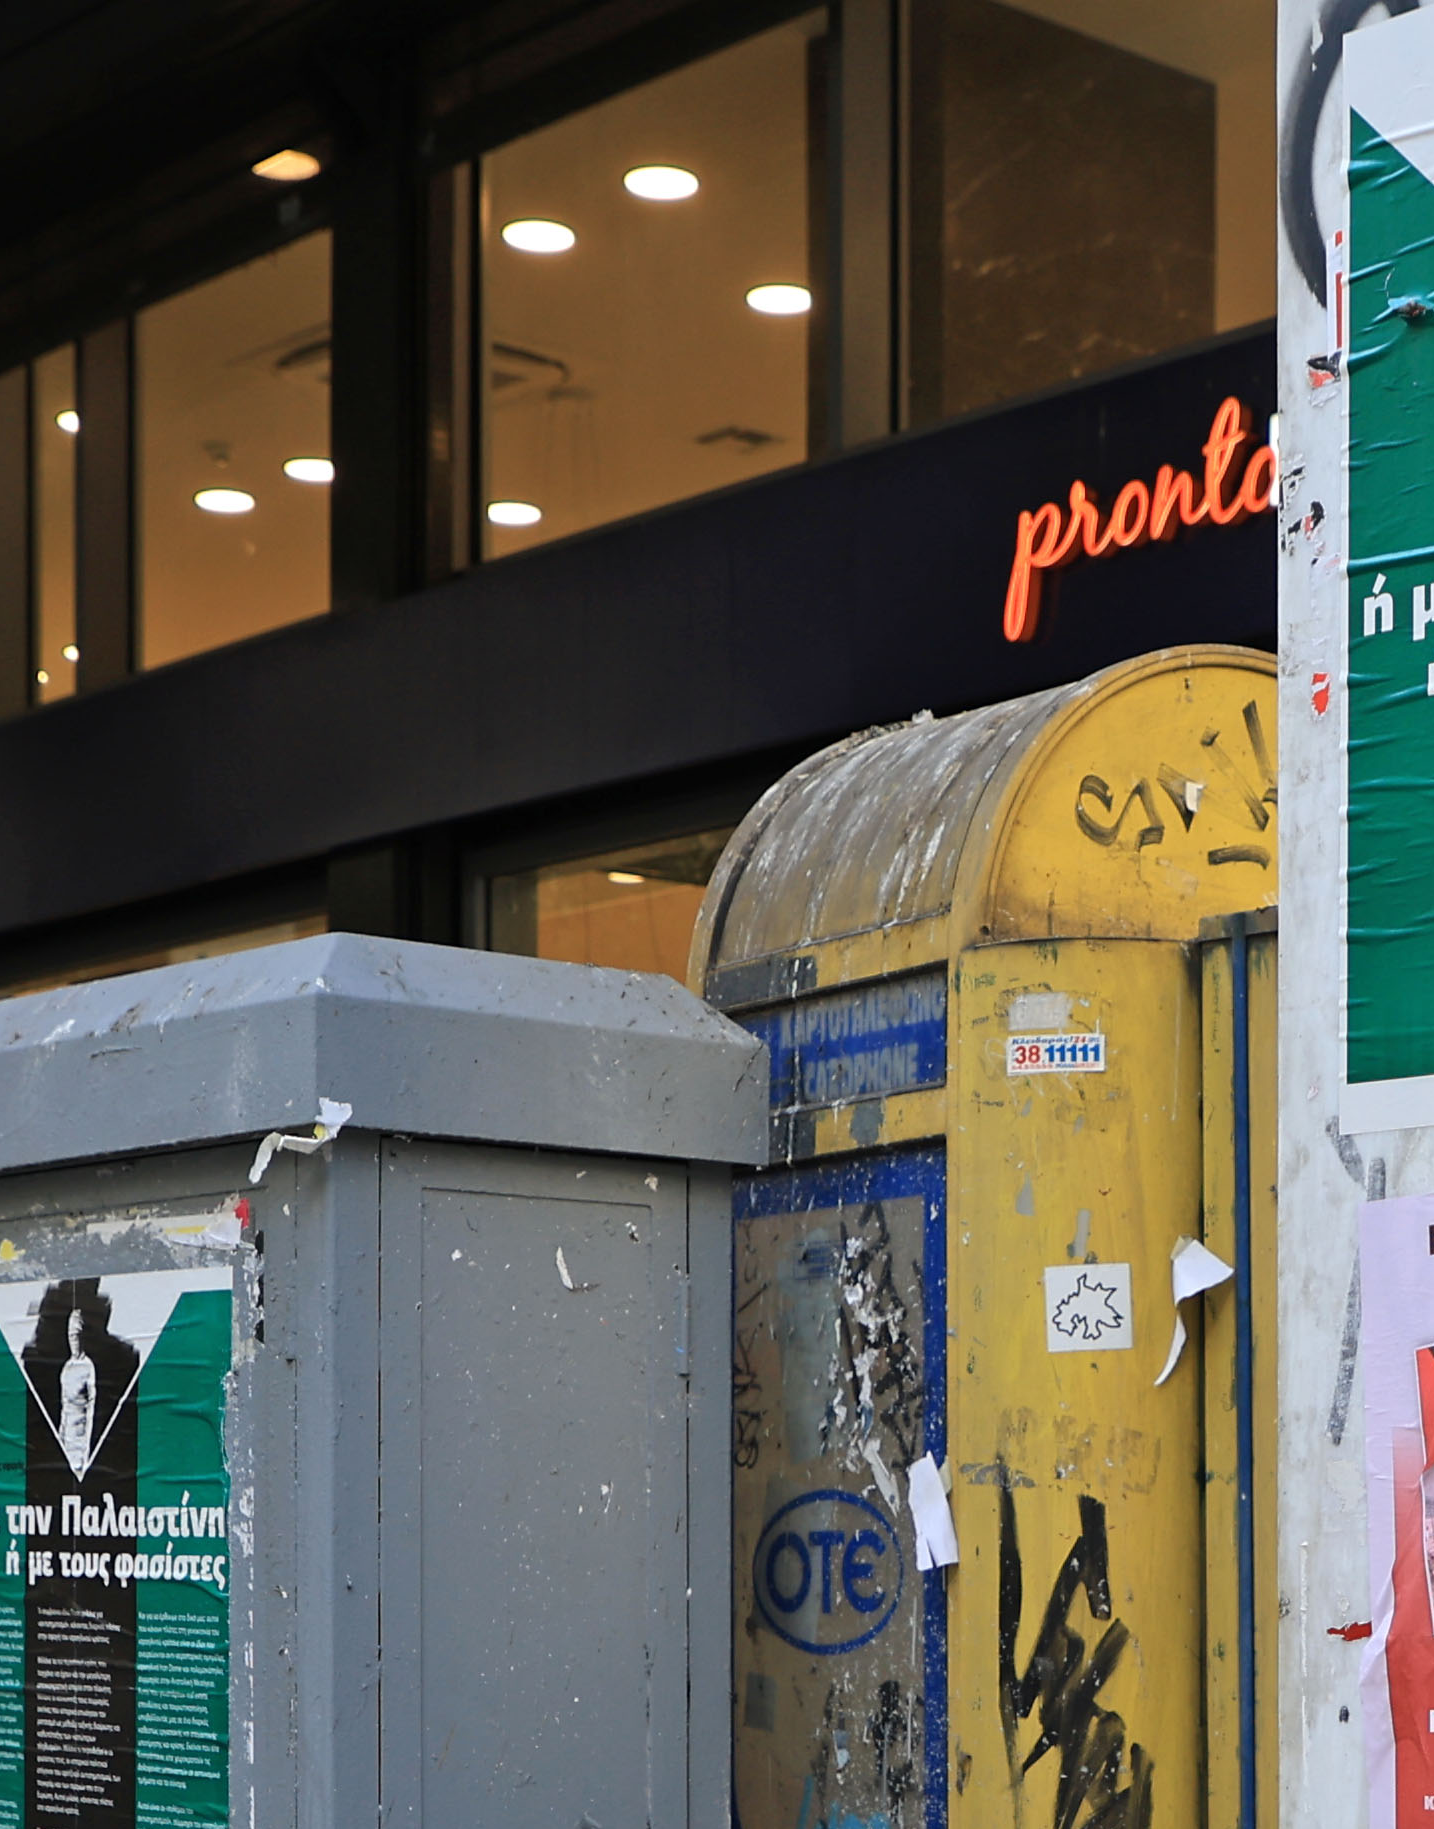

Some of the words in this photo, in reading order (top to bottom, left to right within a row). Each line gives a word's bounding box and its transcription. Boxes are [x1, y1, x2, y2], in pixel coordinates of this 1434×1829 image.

[1364, 573, 1394, 637] ή
[1014, 1044, 1041, 1064] 38
[5, 1503, 54, 1536] την
[60, 1489, 226, 1539] Παλαιστίνη
[5, 1537, 21, 1577] ή
[28, 1549, 54, 1587] με
[59, 1551, 111, 1588] τους
[114, 1540, 226, 1592] φασίστες
